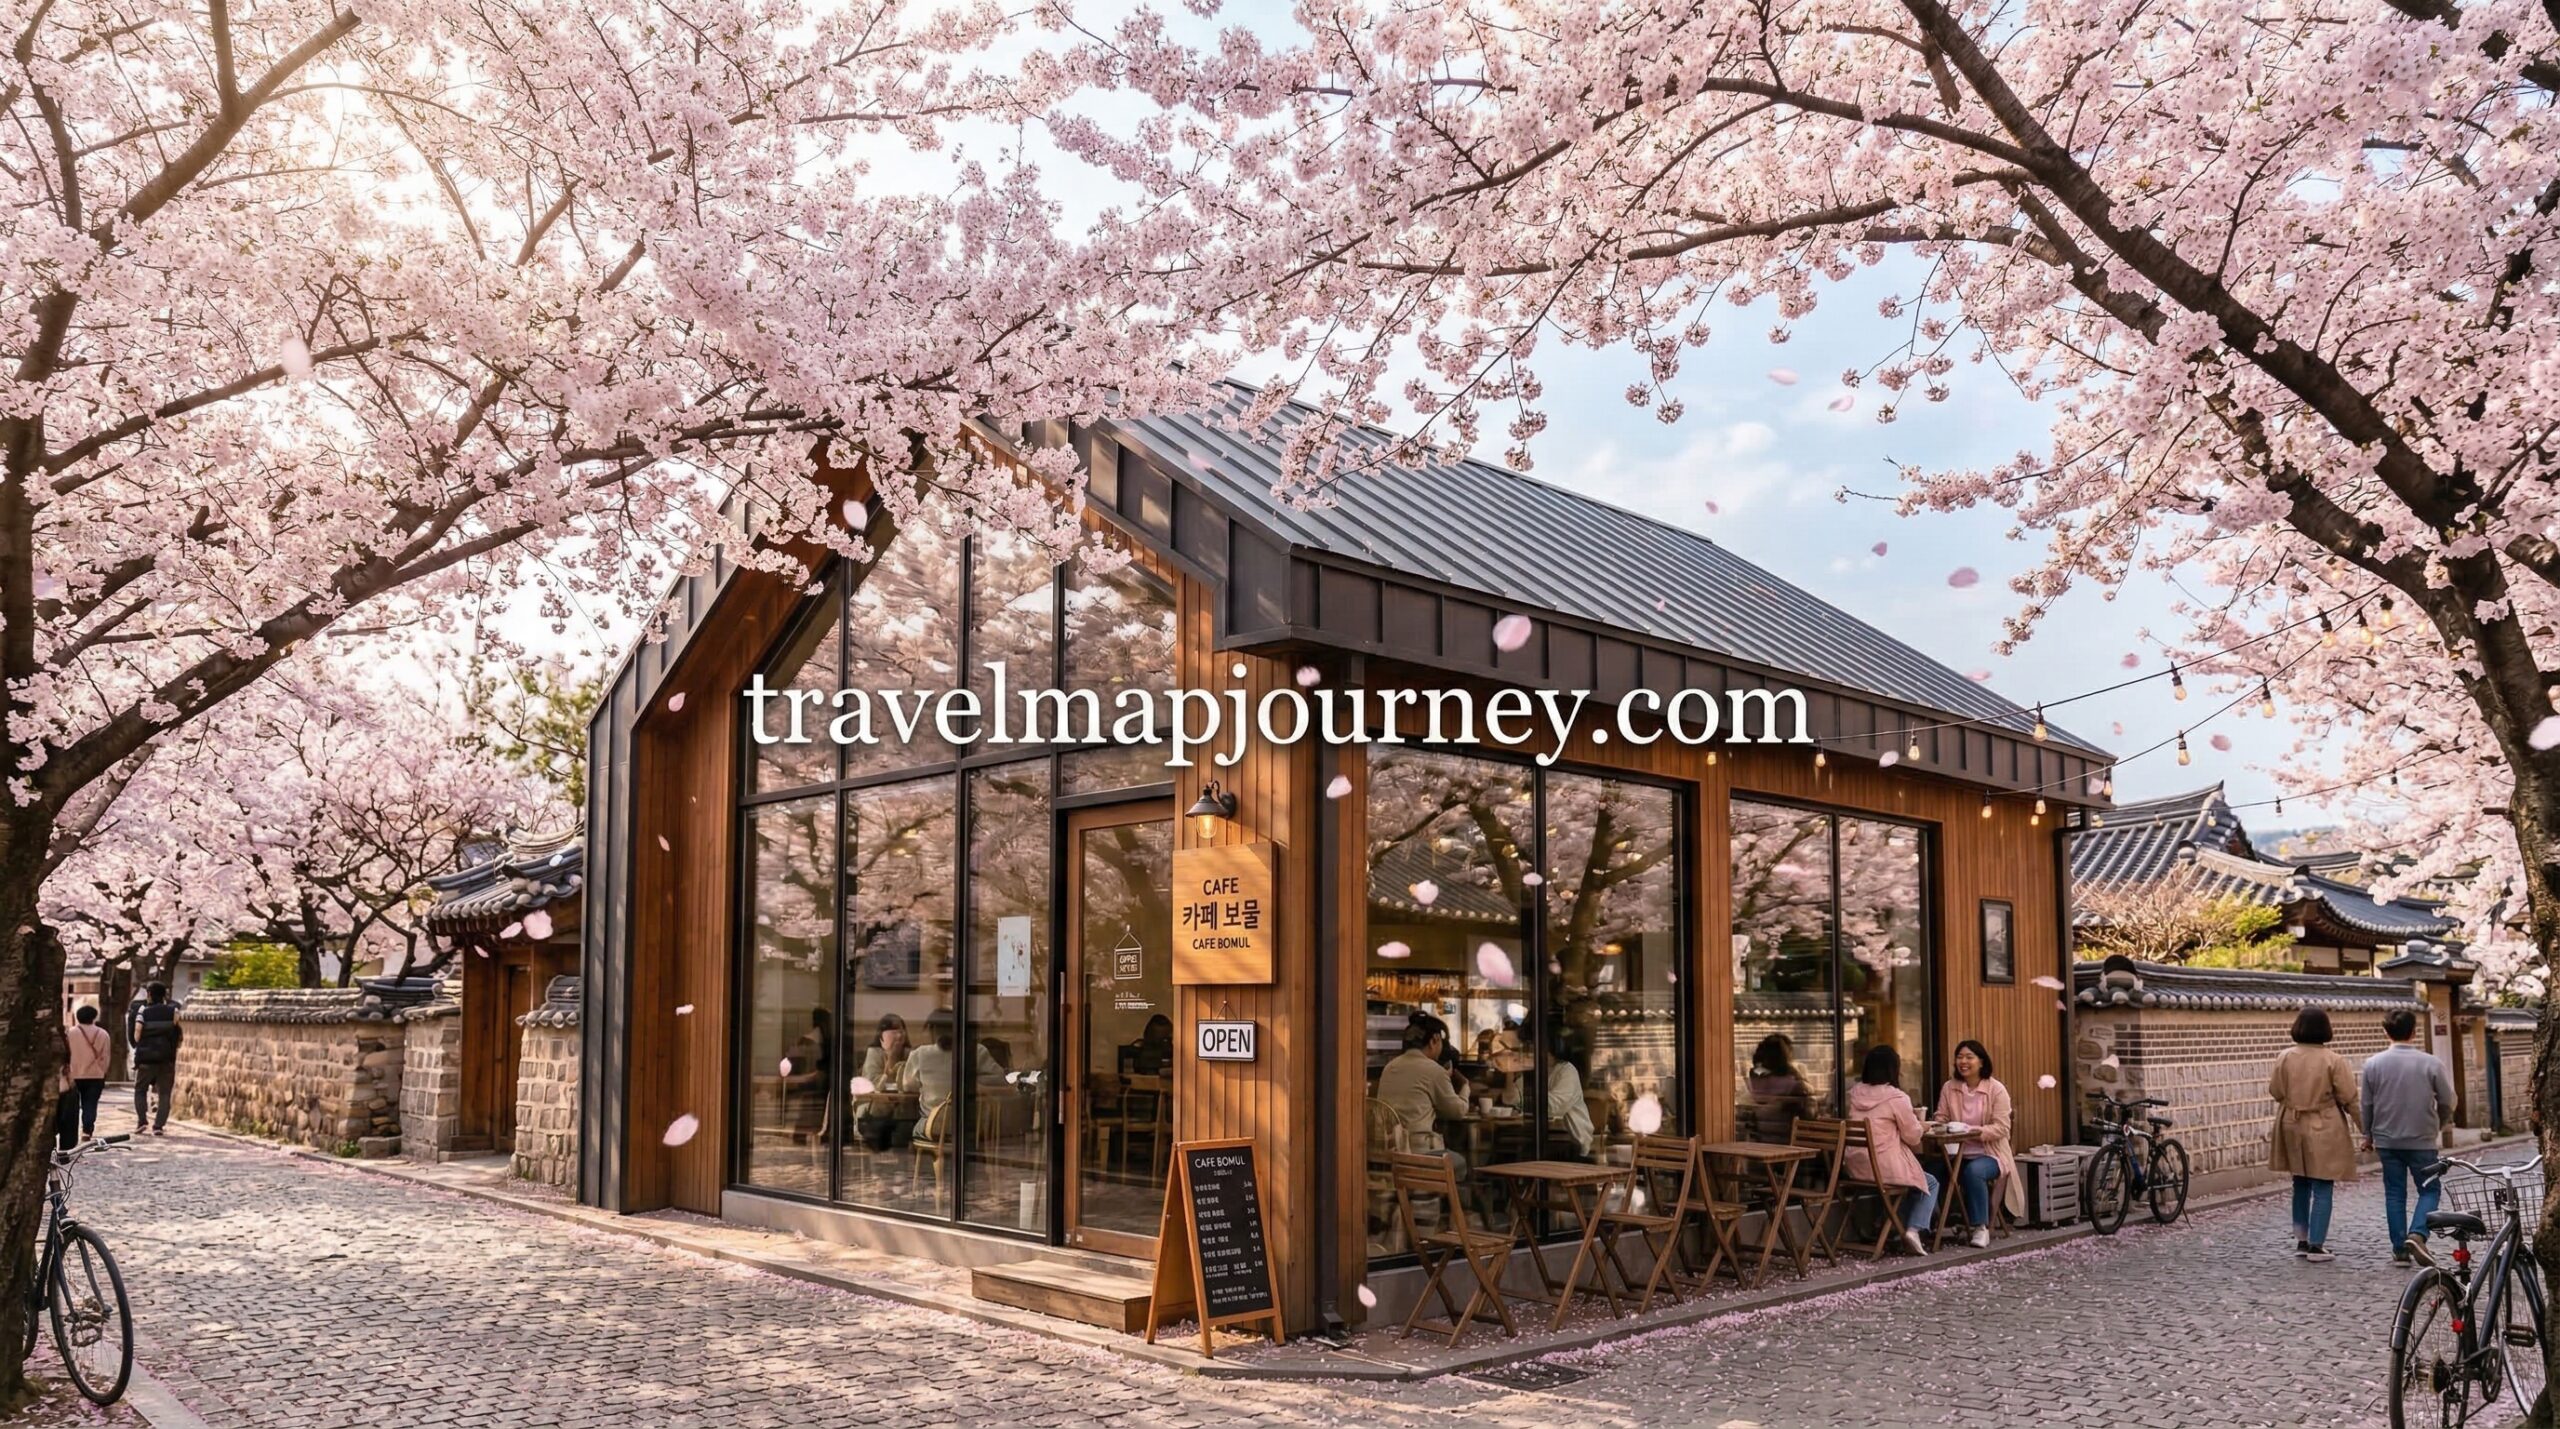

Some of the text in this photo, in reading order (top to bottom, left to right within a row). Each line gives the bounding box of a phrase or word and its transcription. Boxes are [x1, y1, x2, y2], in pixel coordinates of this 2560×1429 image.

[1203, 877, 1239, 896] CAFE
[1183, 899, 1261, 931] 카페 보물
[1192, 937, 1251, 950] CAFE BOMUL
[1202, 1028, 1251, 1053] OPEN
[1194, 1155, 1246, 1168] CAFE BOMUL
